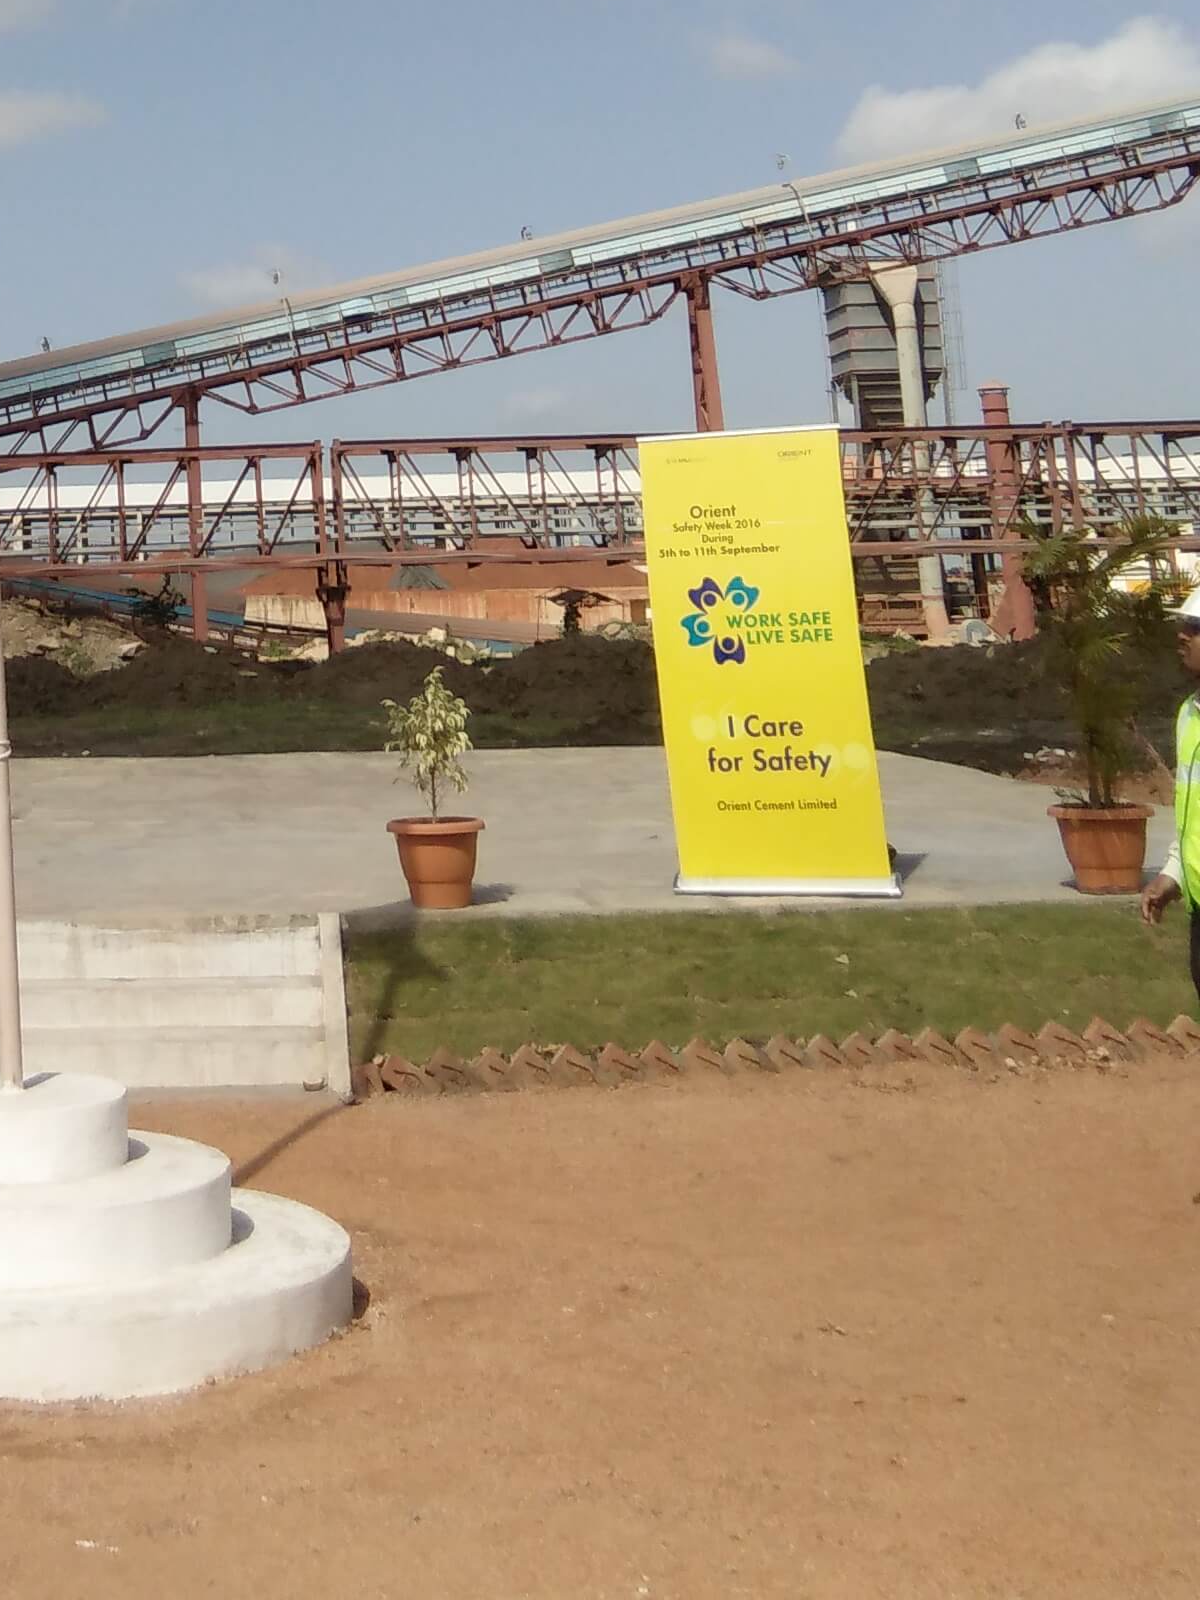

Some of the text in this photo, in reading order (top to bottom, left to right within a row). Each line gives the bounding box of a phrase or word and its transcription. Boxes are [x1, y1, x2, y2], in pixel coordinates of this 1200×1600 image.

[689, 505, 737, 519] Orient
[672, 518, 761, 534] Safety Week 2016
[701, 534, 734, 544] During
[658, 543, 781, 558] 5th to 11th September
[726, 611, 831, 629] WORK SAFE
[746, 628, 833, 645] LIVE SAFE
[728, 714, 804, 738] I Care
[708, 745, 832, 778] for Safety
[717, 798, 837, 811] Orient Cement Limited
